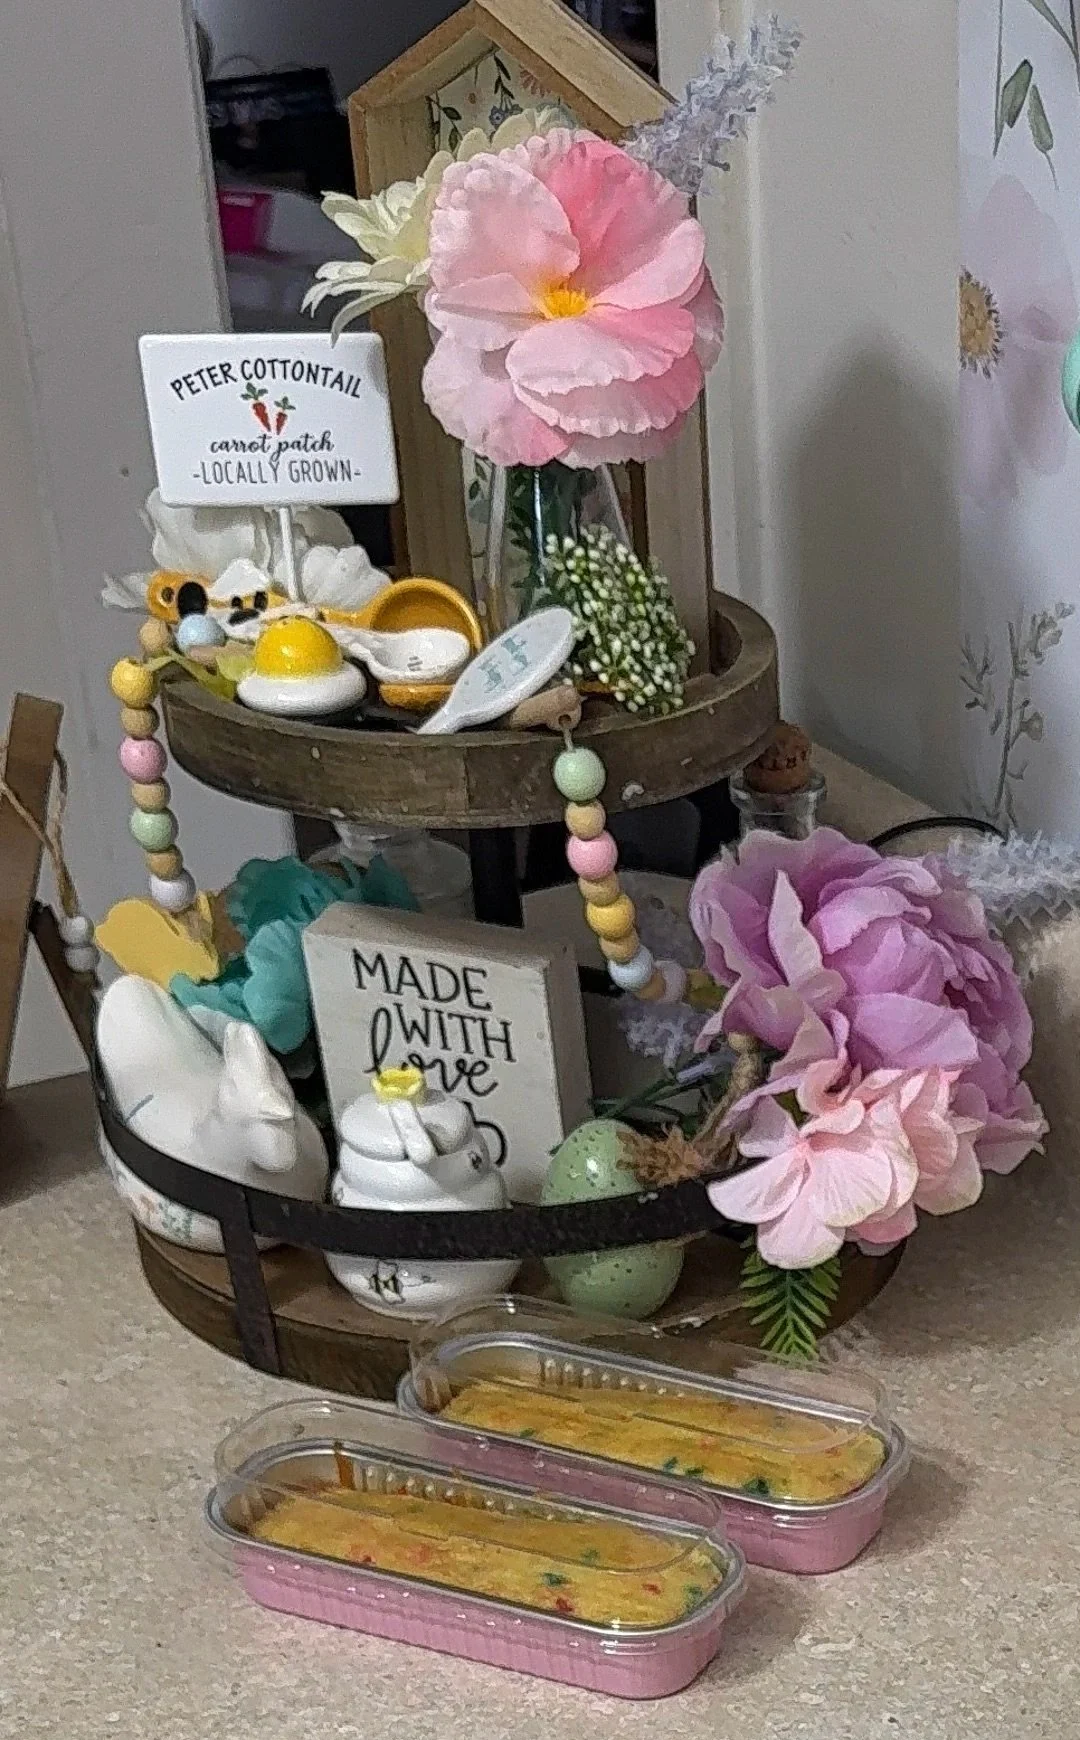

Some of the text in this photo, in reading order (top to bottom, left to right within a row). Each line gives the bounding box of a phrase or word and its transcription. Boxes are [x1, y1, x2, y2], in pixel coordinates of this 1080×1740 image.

[170, 358, 362, 401] PETER COTTONTAIL
[210, 430, 335, 462] carrot patch
[352, 948, 492, 1011] MADE
[393, 1002, 517, 1063] WITH
